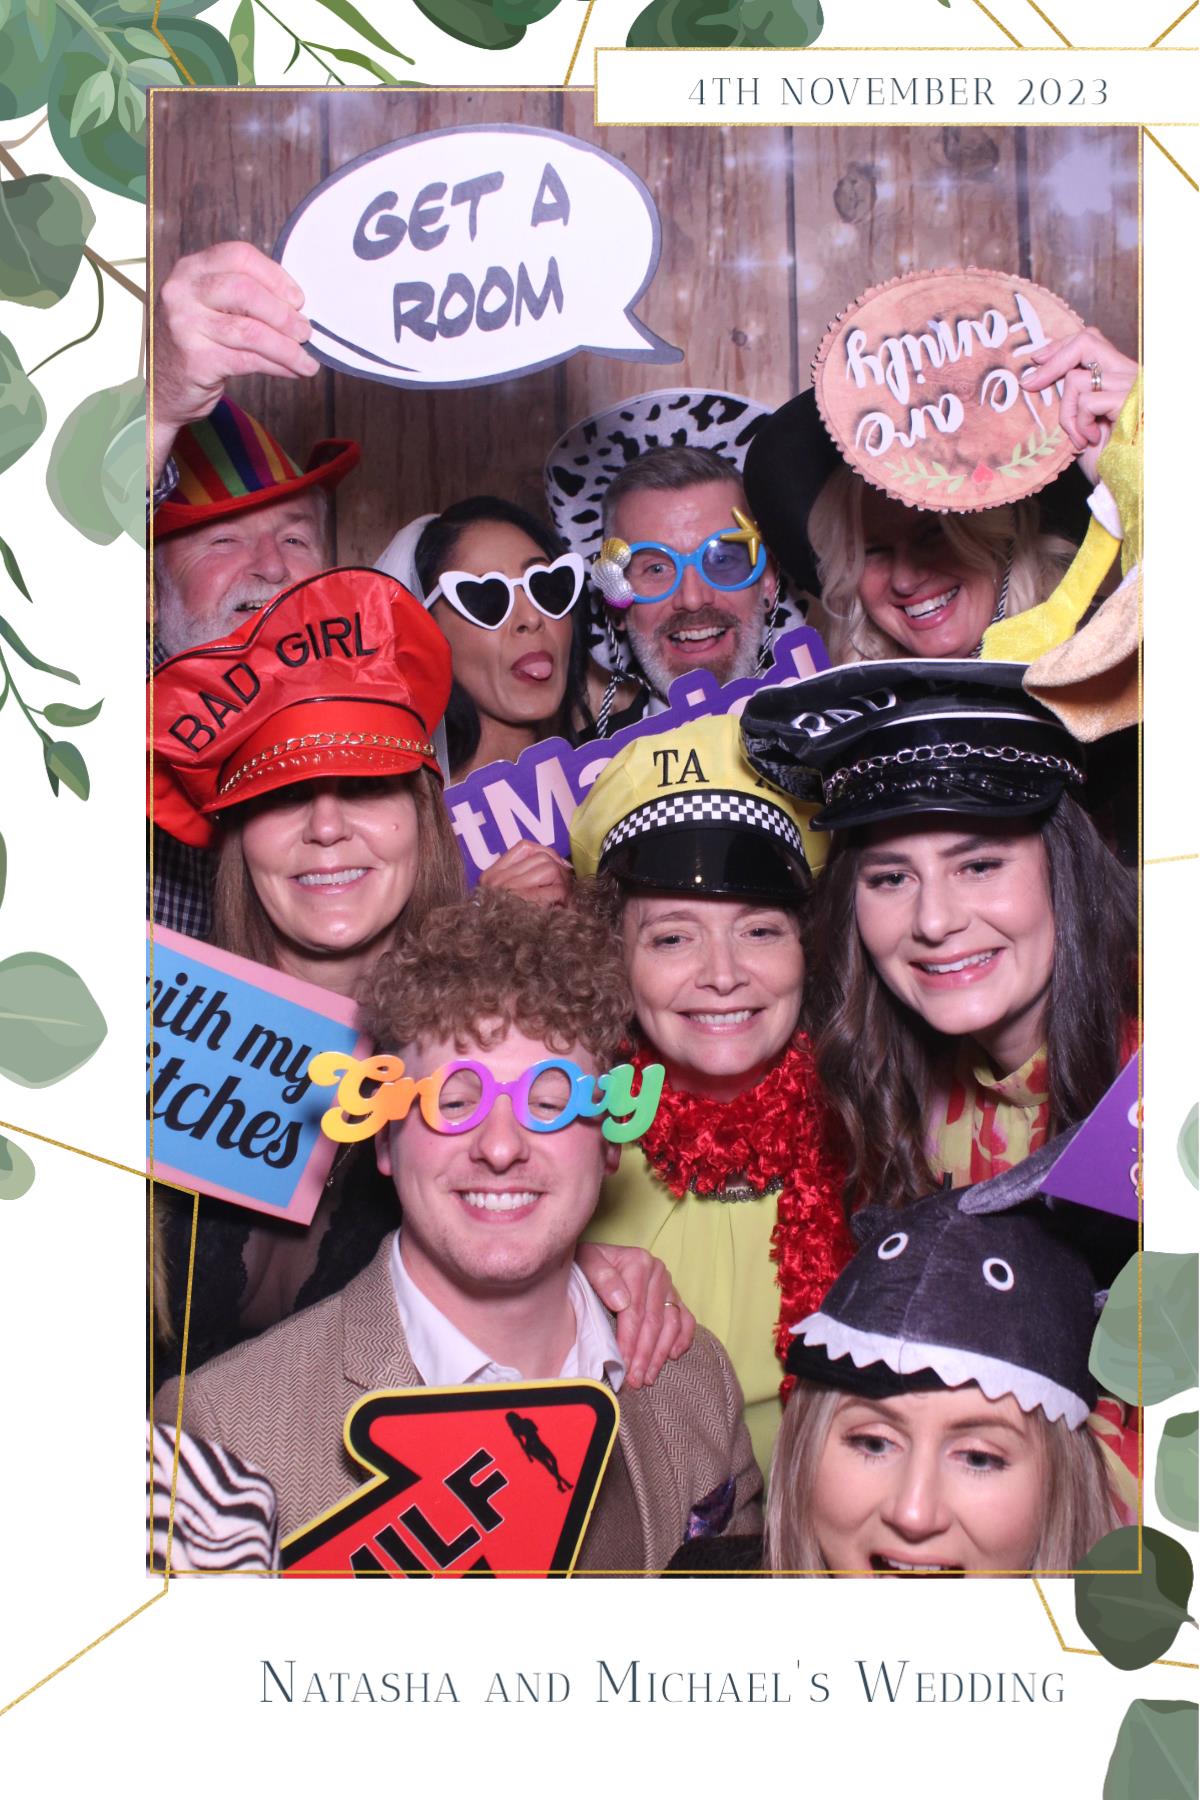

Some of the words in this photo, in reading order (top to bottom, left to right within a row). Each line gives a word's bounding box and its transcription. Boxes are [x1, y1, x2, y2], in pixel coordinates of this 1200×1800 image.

[353, 171, 504, 261] GET
[530, 162, 571, 228] A
[393, 256, 564, 343] ROOM
[845, 292, 1051, 406] Family
[855, 393, 964, 457] are
[169, 662, 261, 753] BAD
[275, 612, 379, 669] GIRL
[232, 1023, 313, 1105] my
